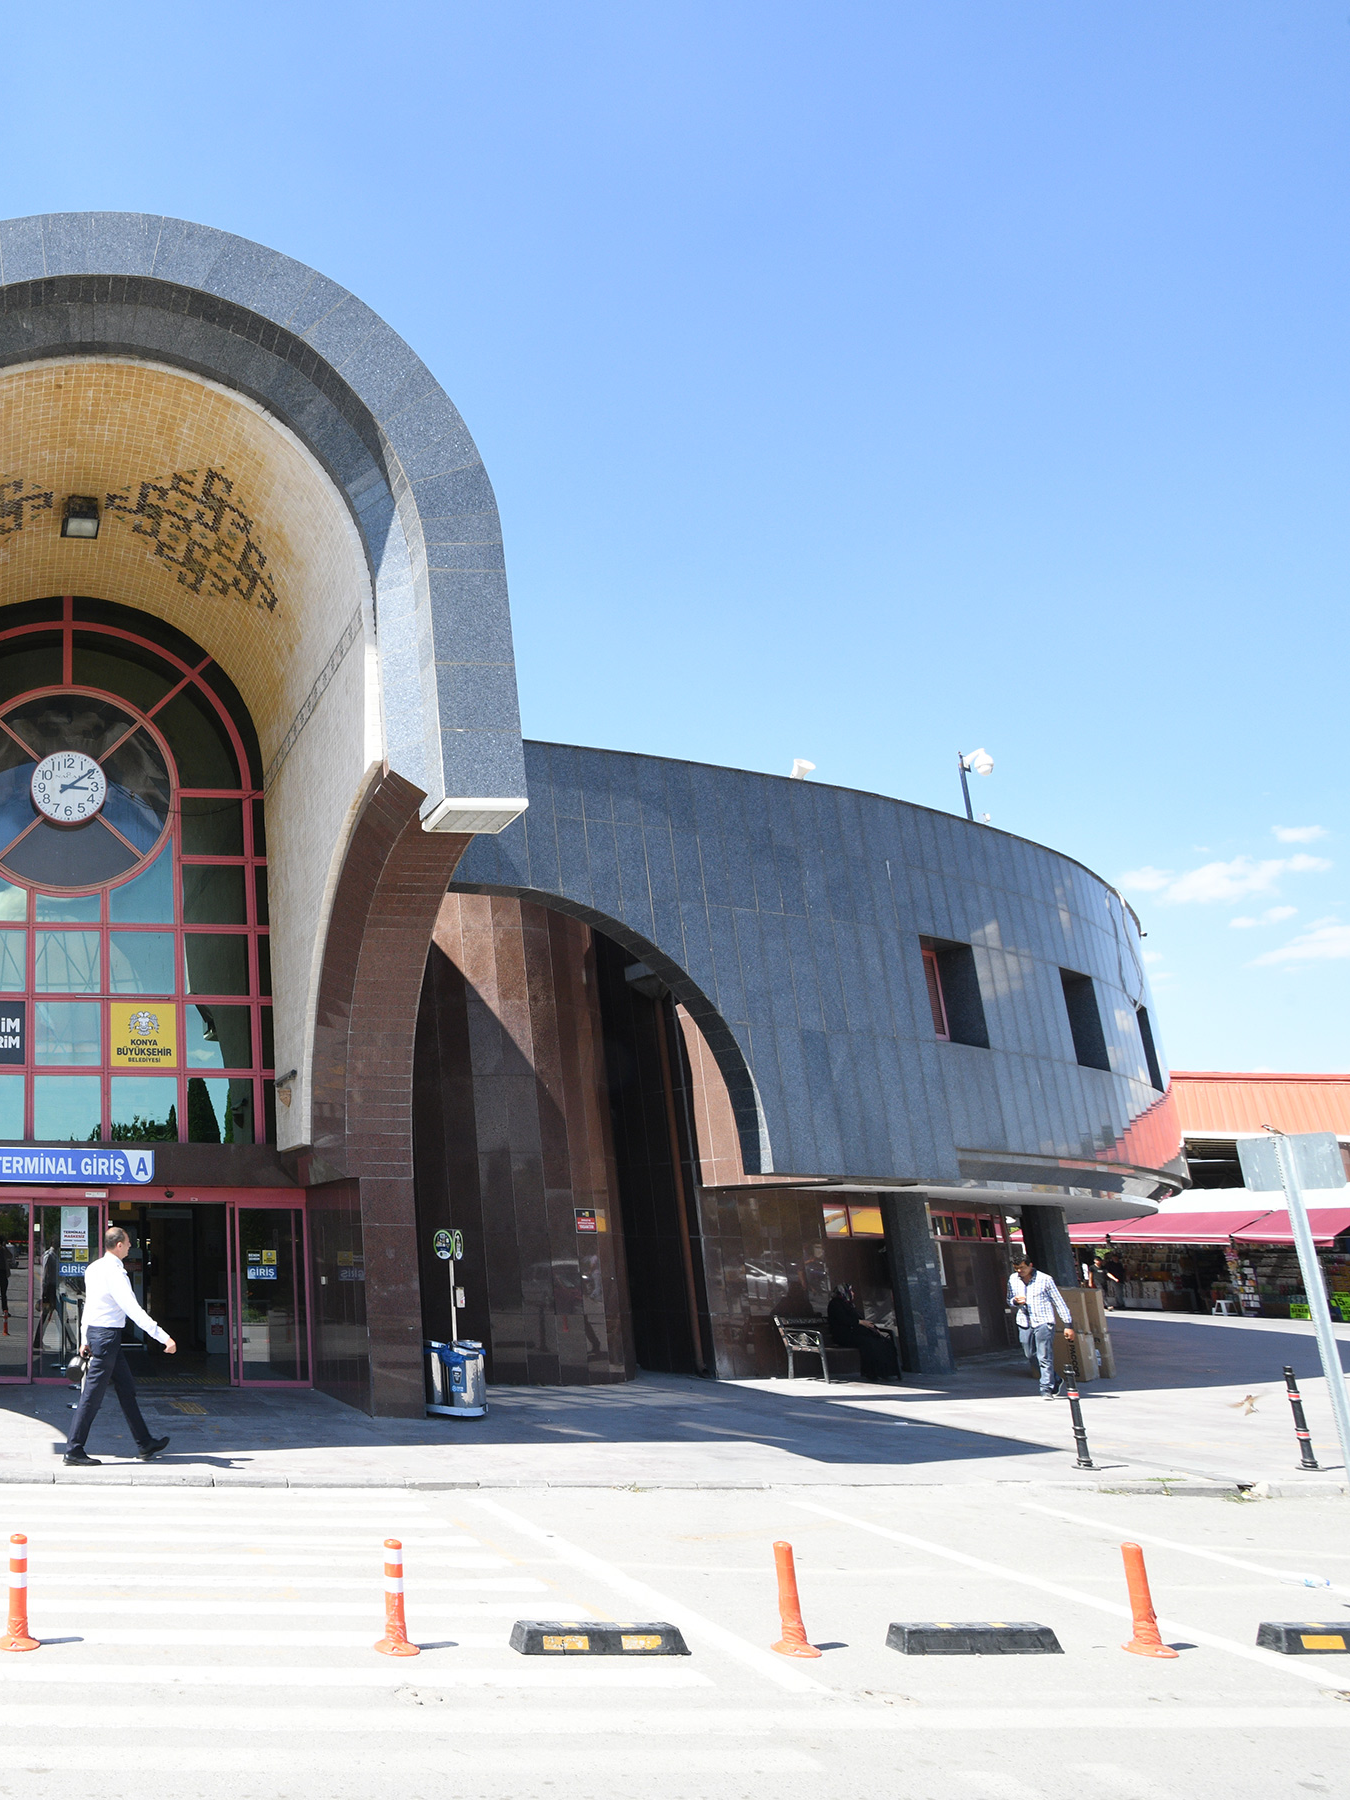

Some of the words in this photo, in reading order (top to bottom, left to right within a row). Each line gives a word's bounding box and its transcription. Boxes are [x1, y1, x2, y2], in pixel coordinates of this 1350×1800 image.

[52, 761, 60, 771] 11
[64, 758, 74, 768] 12
[42, 770, 52, 780] 10
[87, 769, 95, 779] 2
[38, 783, 46, 793] 9
[91, 782, 99, 792] 3
[43, 794, 50, 804] 8
[87, 794, 95, 803] 4
[53, 803, 60, 813] 7
[64, 806, 72, 816] 6
[78, 803, 85, 813] 5
[116, 1047, 172, 1057] BÜYÜKŞEHİR
[80, 1154, 125, 1180] GİRİŞ
[135, 1157, 148, 1176] A
[249, 1267, 275, 1278] GİRİŞ
